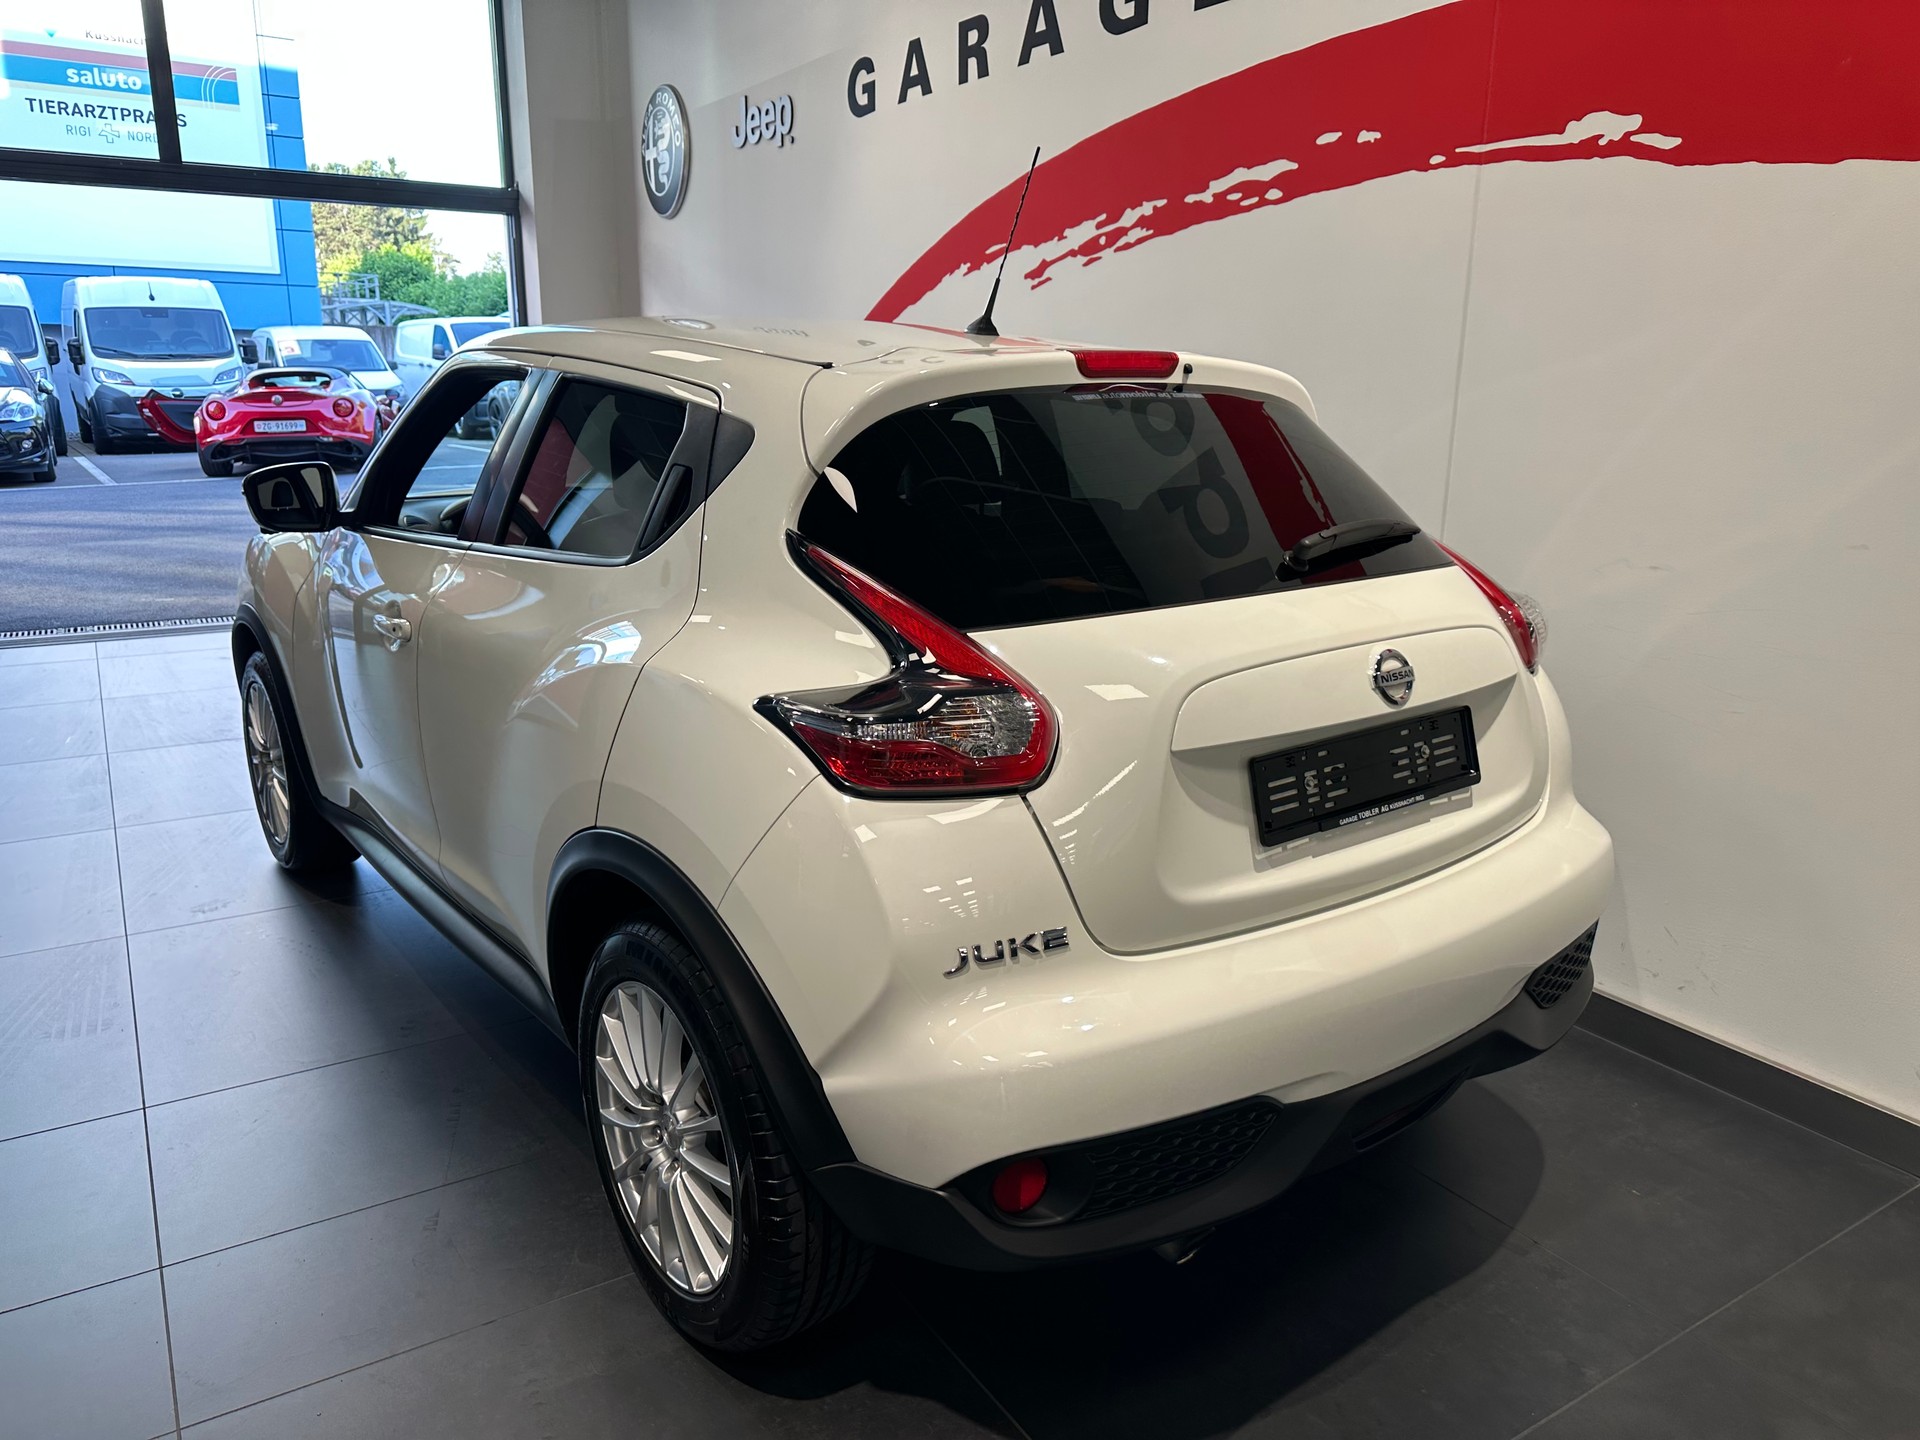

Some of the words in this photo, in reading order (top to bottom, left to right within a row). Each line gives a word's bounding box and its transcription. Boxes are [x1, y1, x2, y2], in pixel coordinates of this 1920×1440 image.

[847, 0, 1231, 118] GARAG
[66, 66, 142, 91] saluto
[25, 97, 188, 128] TIERARZTPRAS
[656, 91, 681, 147] ROMEO
[66, 124, 91, 137] RIGI
[1380, 669, 1414, 684] NISSAN
[1339, 815, 1358, 825] GARAGE
[1358, 807, 1380, 819] TOBLER
[1381, 804, 1389, 813] AG
[943, 926, 1070, 977] JUKE
